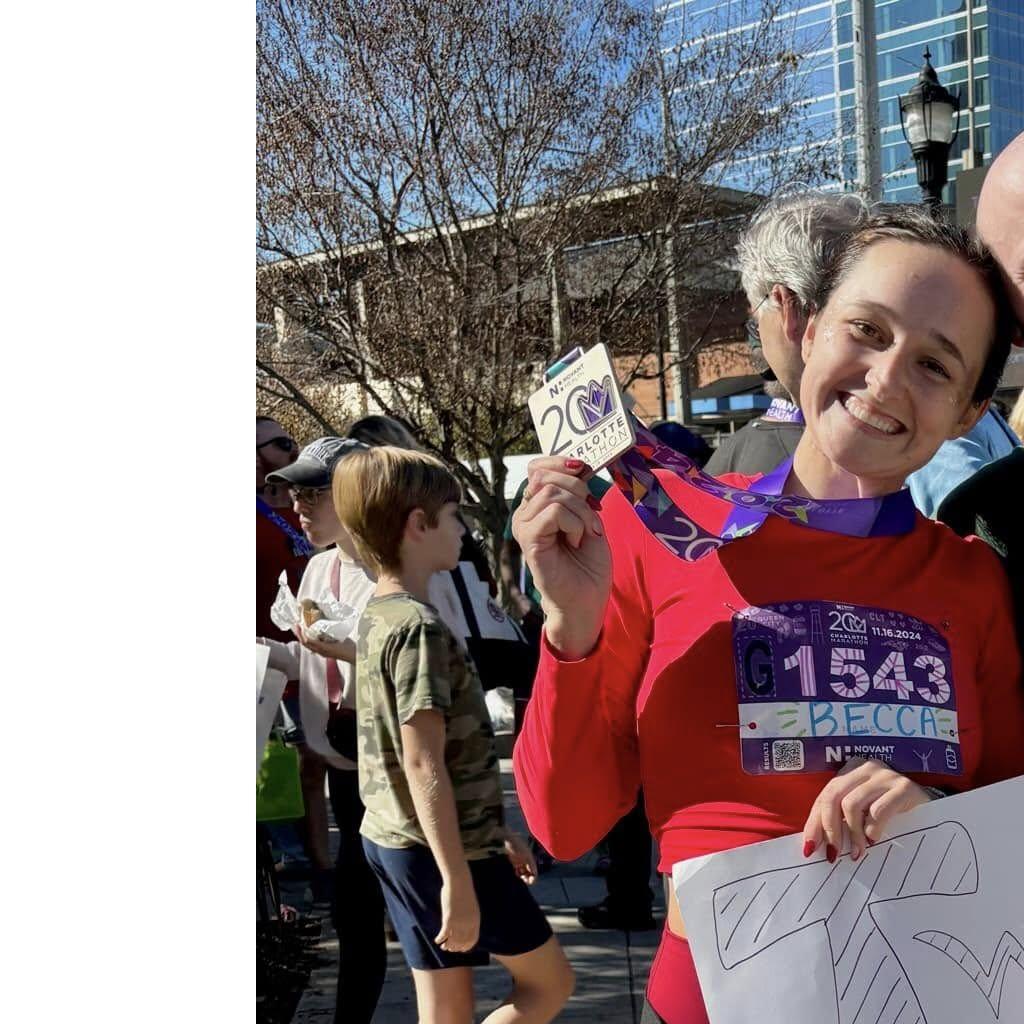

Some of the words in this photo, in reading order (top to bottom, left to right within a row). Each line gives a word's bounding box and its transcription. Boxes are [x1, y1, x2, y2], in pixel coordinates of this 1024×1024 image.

[871, 626, 922, 641] 11.16.2024
[743, 639, 775, 696] G
[784, 645, 951, 704] 1543
[809, 701, 937, 737] BECCA
[855, 745, 896, 754] NOVANT
